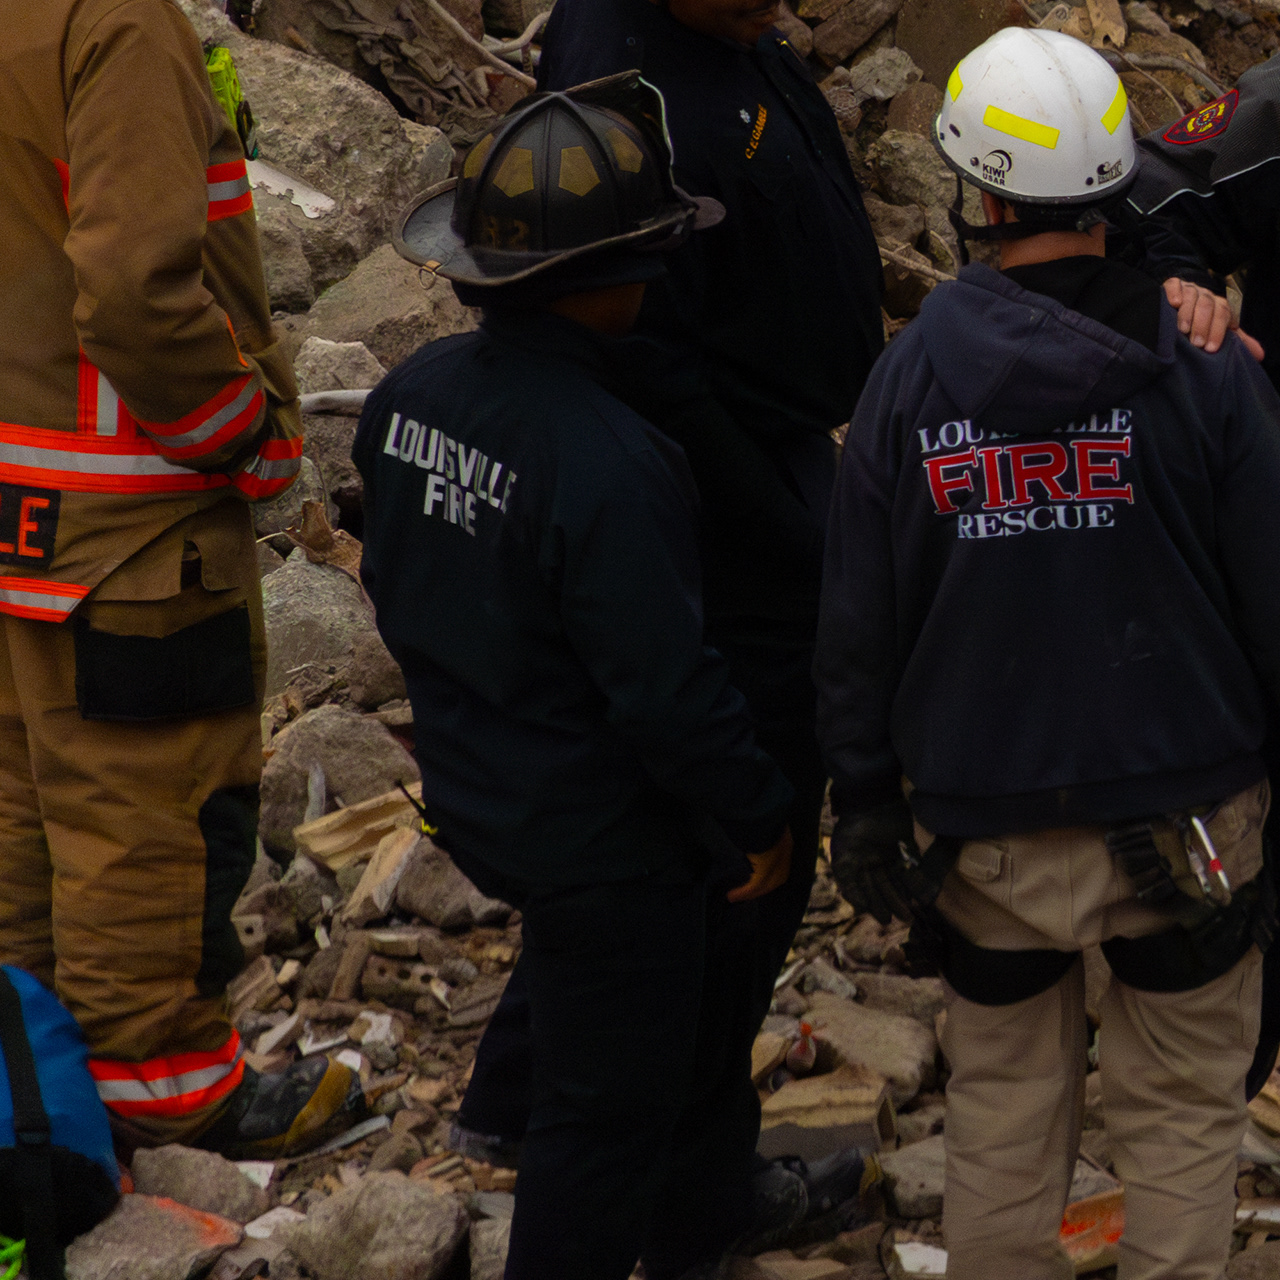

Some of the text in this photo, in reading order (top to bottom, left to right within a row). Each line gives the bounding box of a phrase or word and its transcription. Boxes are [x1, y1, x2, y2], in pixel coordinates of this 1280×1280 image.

[982, 163, 1005, 179] KIWI
[982, 174, 1005, 186] USAR
[383, 412, 517, 515] LOUISVILLE
[923, 435, 1135, 515] FIRE
[423, 473, 478, 537] FIRE
[957, 503, 1115, 539] RESCUE
